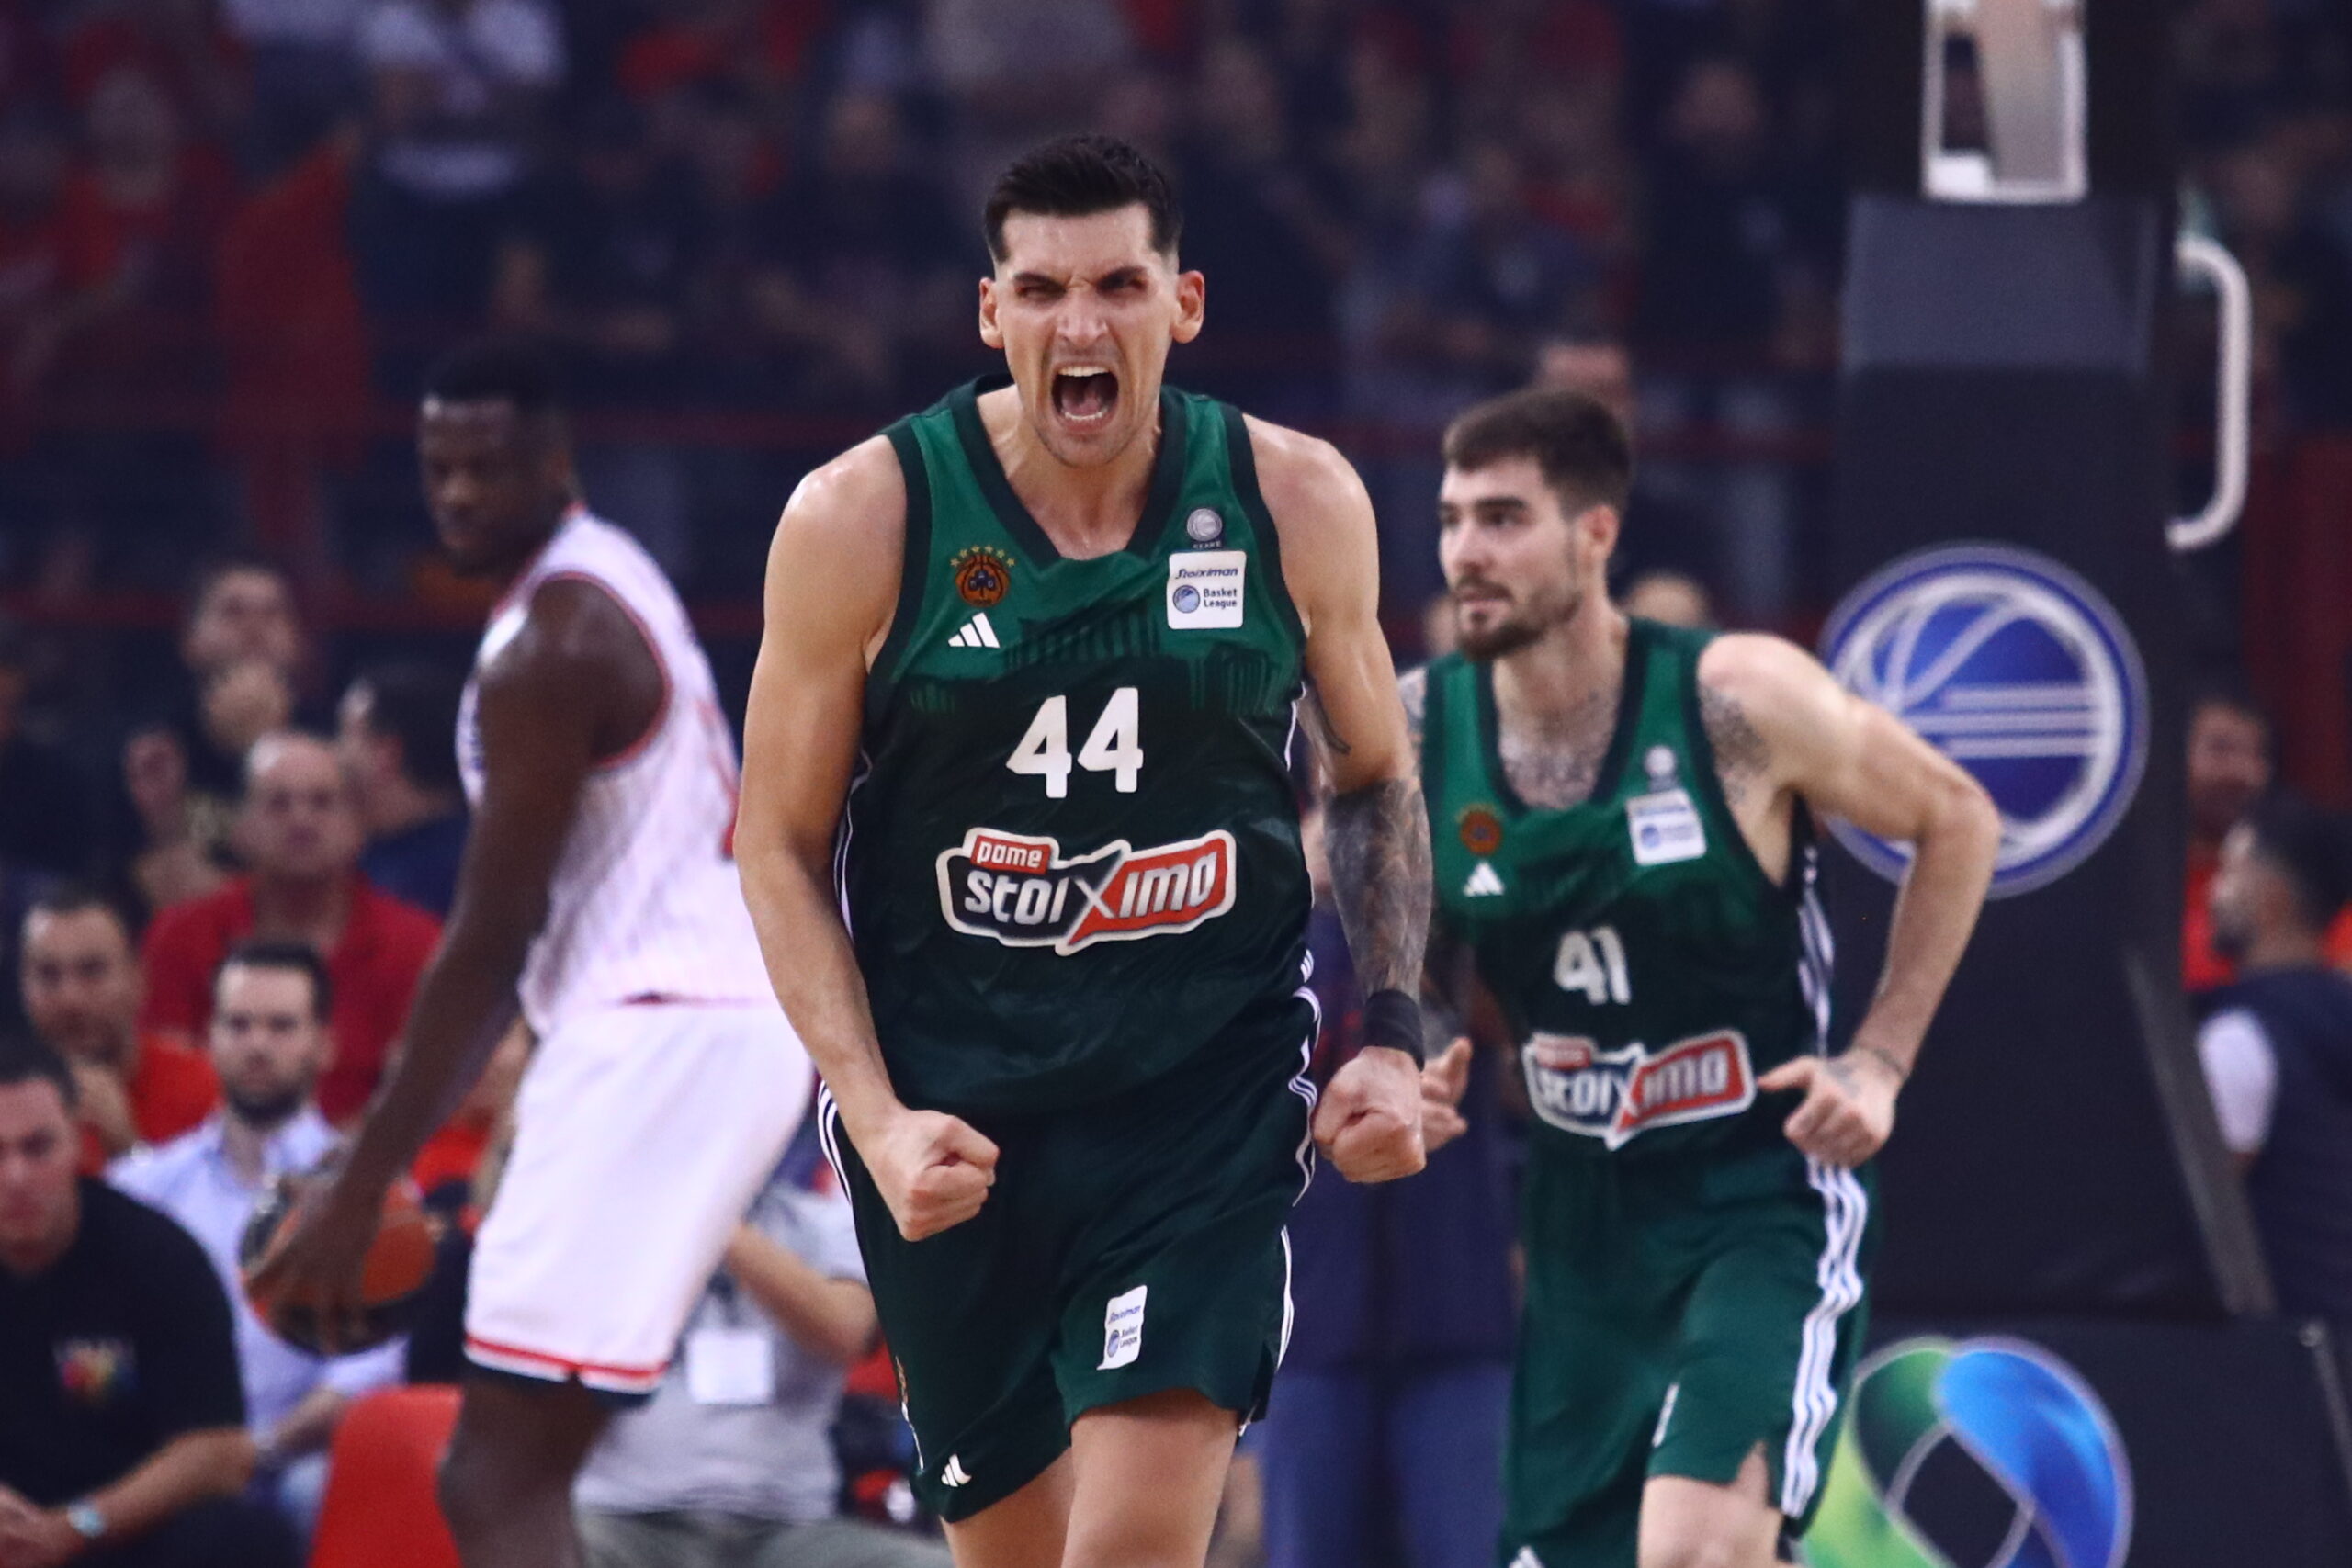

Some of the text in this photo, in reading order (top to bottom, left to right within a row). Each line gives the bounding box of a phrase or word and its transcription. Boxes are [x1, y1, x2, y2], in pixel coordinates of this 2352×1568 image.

[1204, 588, 1238, 598] Basket
[1204, 599, 1238, 609] League
[1006, 687, 1144, 798] 44
[977, 841, 1042, 868] pame
[1554, 926, 1632, 1006] 41
